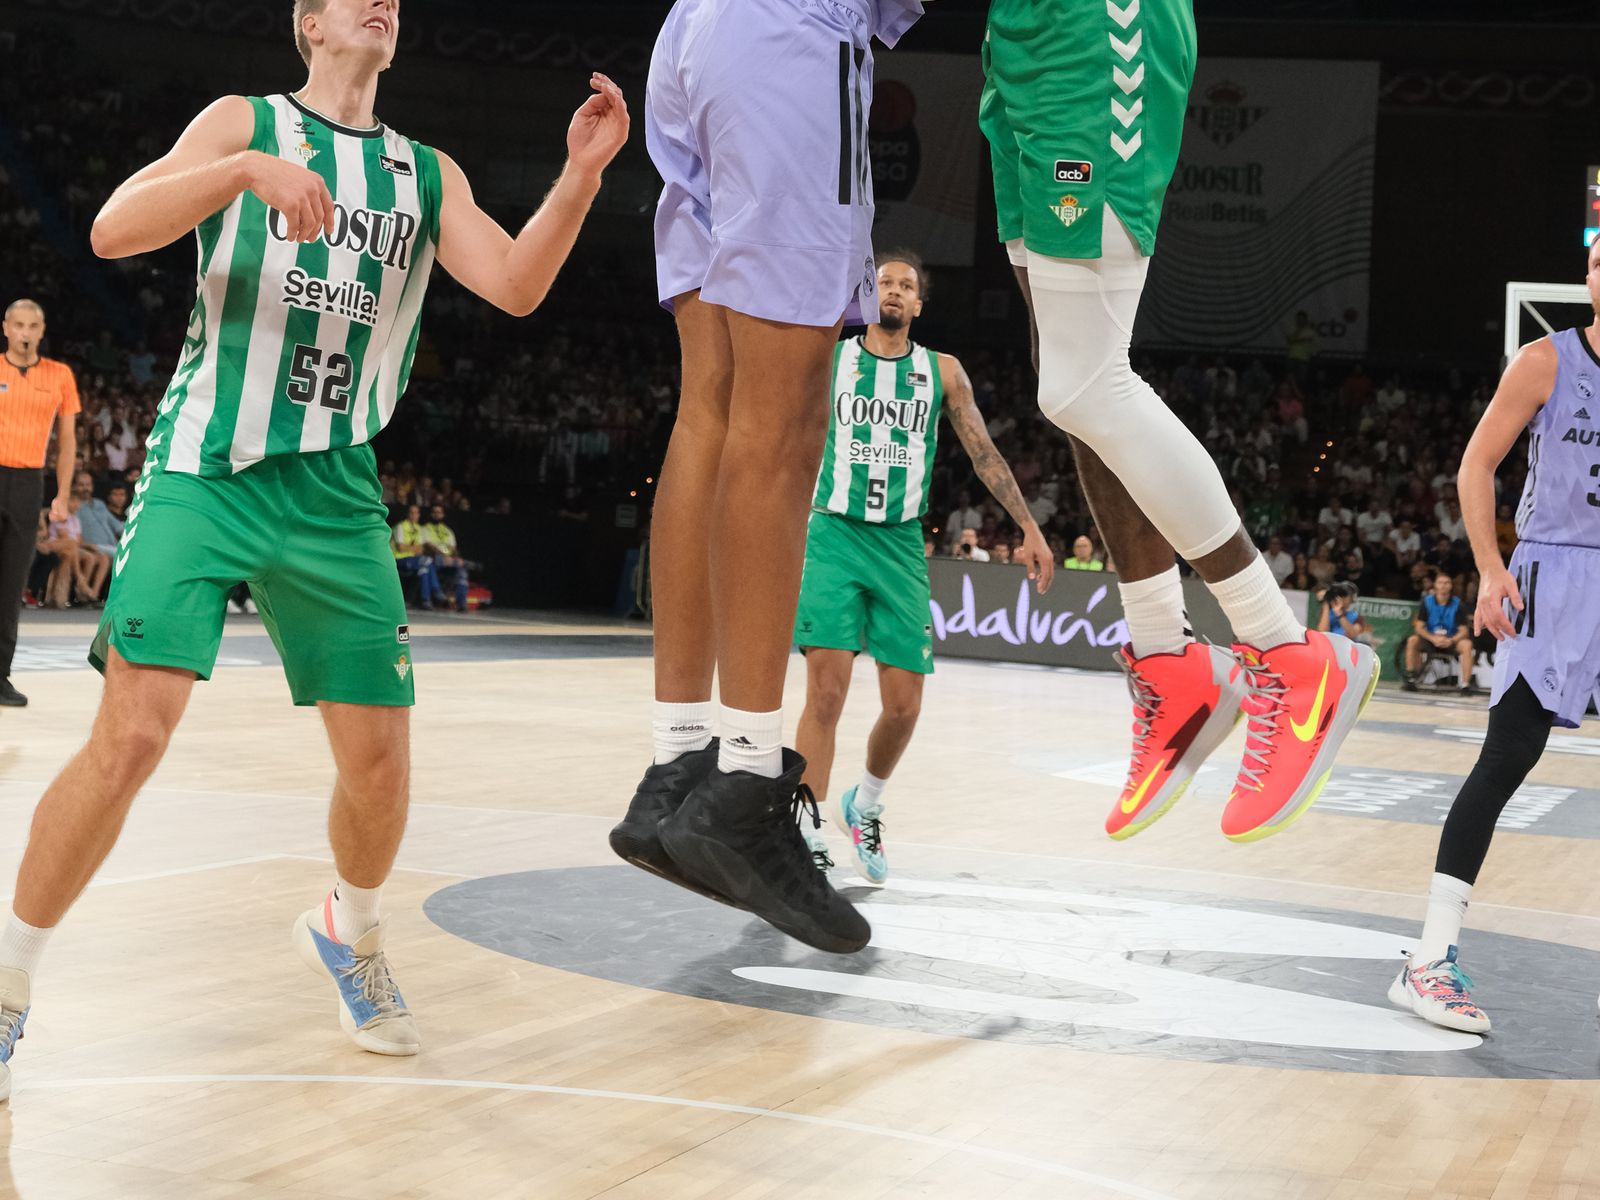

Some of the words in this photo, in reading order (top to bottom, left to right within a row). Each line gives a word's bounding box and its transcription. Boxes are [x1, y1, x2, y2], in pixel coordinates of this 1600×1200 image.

[1057, 169, 1083, 181] acb
[268, 203, 416, 271] COSUR
[286, 342, 353, 415] 52
[836, 391, 929, 434] COOSUR
[866, 478, 886, 510] 5
[928, 573, 1132, 647] dalucía
